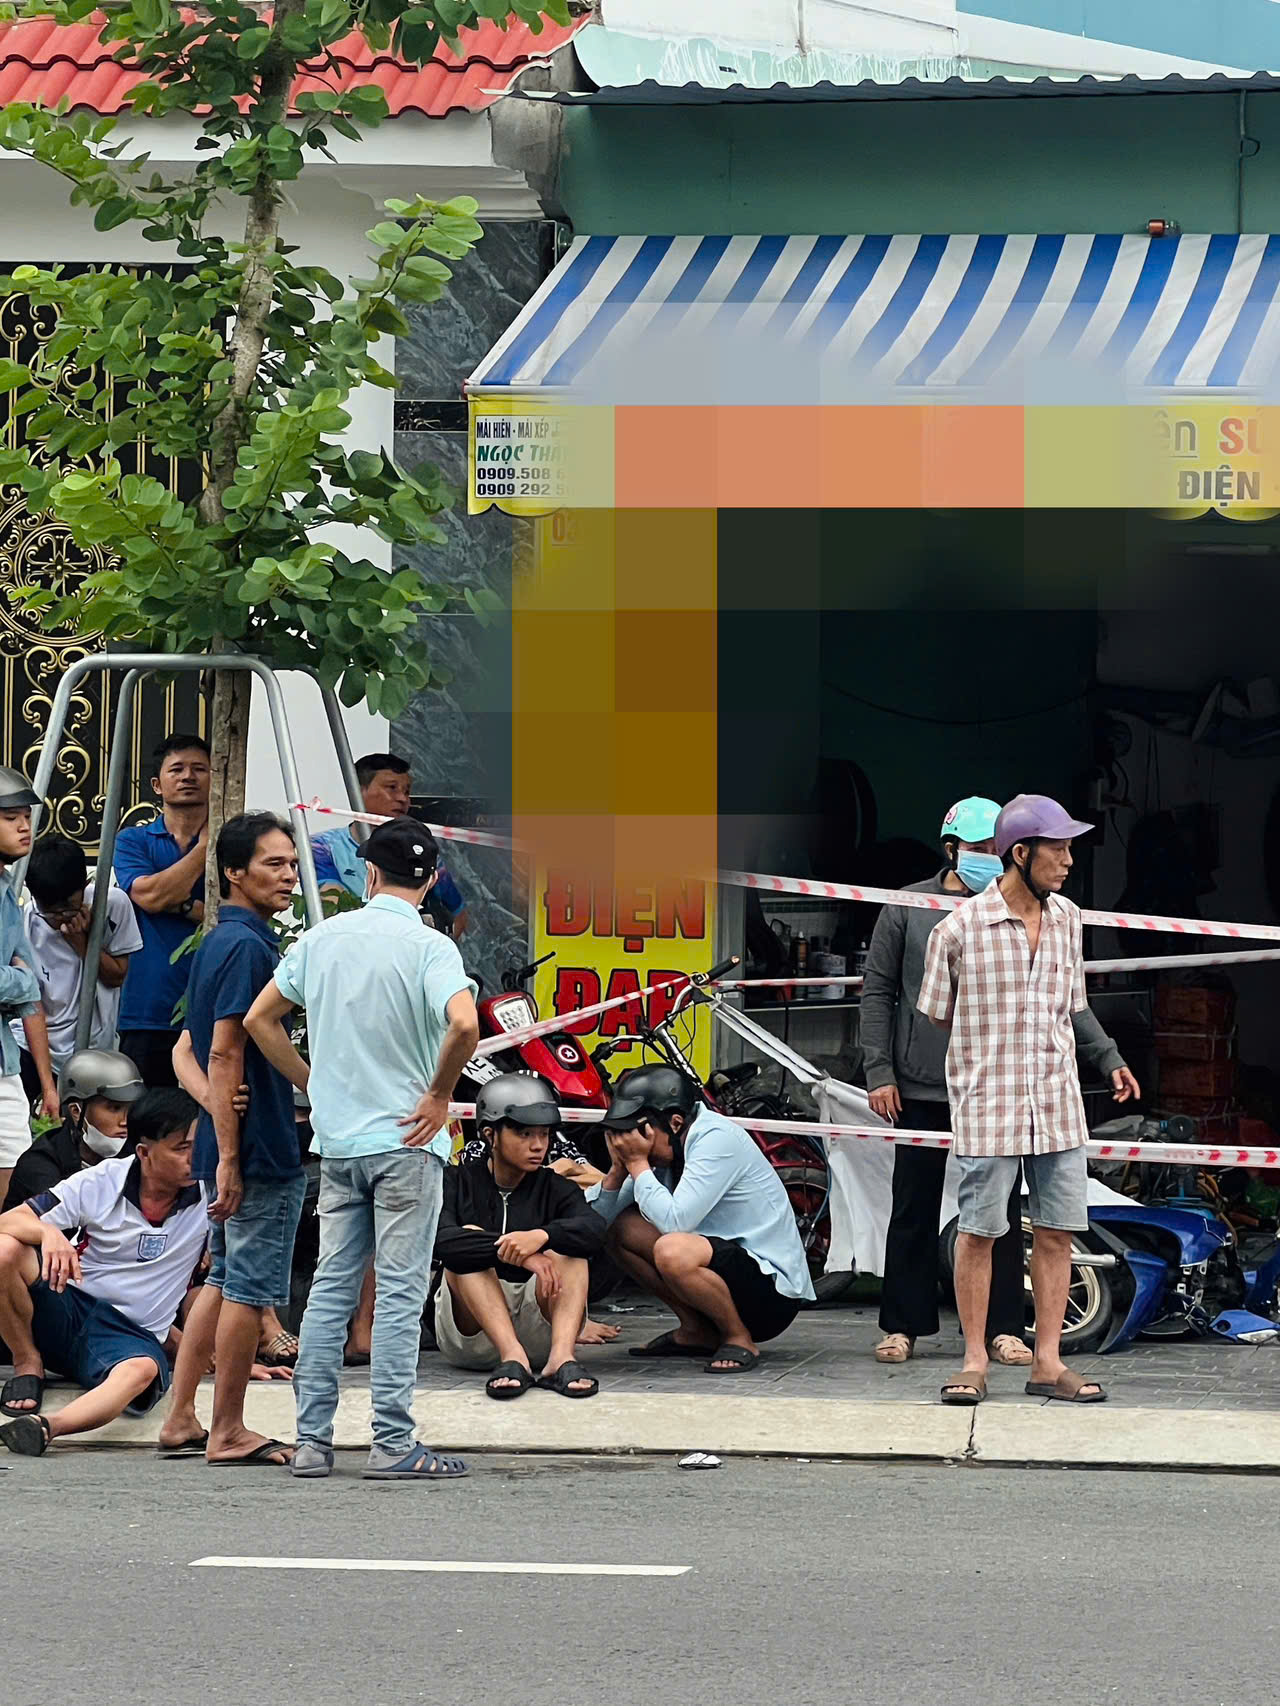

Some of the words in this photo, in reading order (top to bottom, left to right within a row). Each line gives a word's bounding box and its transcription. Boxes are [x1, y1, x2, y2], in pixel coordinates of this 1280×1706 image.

[477, 444, 524, 465] NGỌC
[477, 467, 550, 480] 0909.508
[477, 483, 516, 496] 0909
[520, 483, 550, 496] 292
[1178, 464, 1260, 507] ĐIỆN
